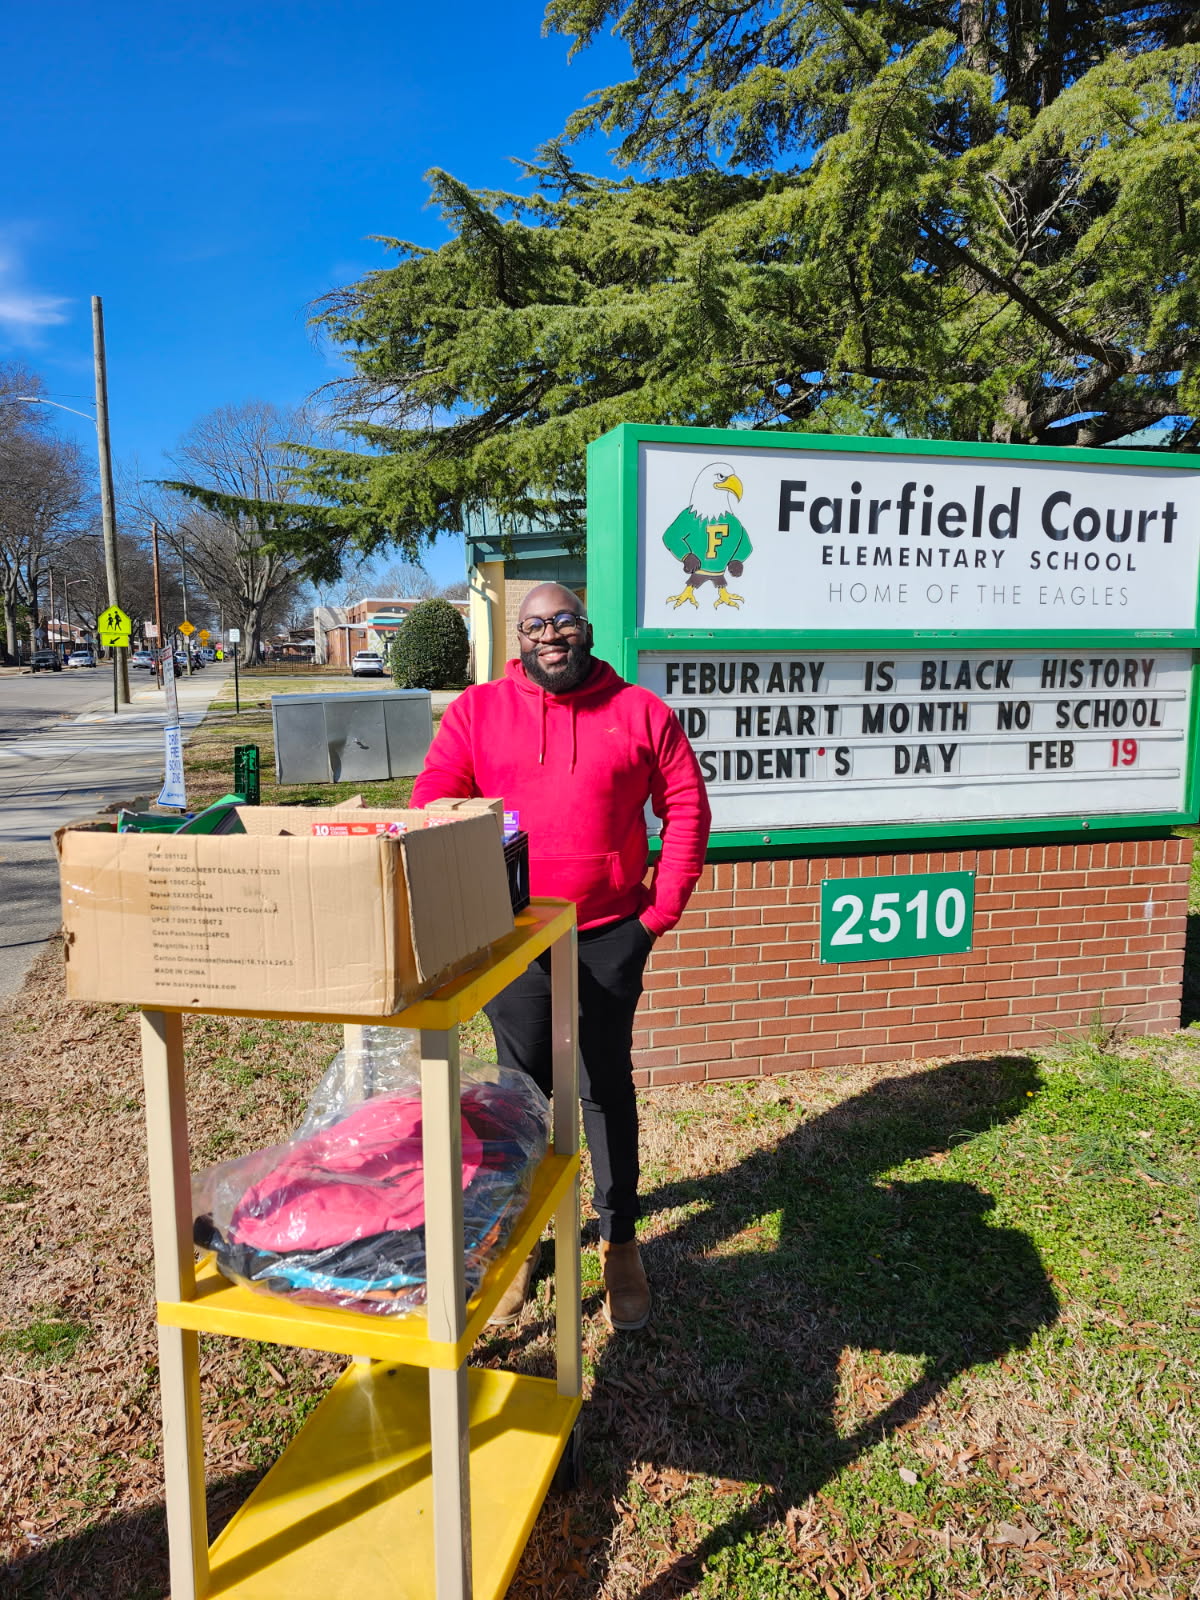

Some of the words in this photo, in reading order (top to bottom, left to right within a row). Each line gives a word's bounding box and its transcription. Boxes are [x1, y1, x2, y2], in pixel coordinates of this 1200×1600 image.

[778, 480, 1021, 540] Fairfield
[1041, 490, 1178, 543] Court
[705, 524, 729, 559] F
[822, 545, 1005, 568] ELEMENTARY
[1030, 550, 1136, 571] SCHOOL
[829, 582, 908, 603] HOME
[926, 584, 959, 604] OF
[977, 585, 1021, 605] THE
[1039, 586, 1128, 606] EAGLES
[666, 662, 825, 694] FEBURARY
[864, 661, 895, 692] IS
[920, 660, 1014, 691] BLACK
[1040, 658, 1155, 689] HISTORY
[735, 704, 839, 737] HEART
[862, 702, 968, 733] MONTH
[997, 701, 1031, 730] NO
[1055, 699, 1161, 729] SCHOOL
[694, 746, 851, 782] SIDENT'S
[894, 743, 958, 774] DAY
[1028, 740, 1074, 770] FEB
[1111, 738, 1139, 767] 19
[315, 825, 329, 836] 10
[830, 888, 966, 946] 2510
